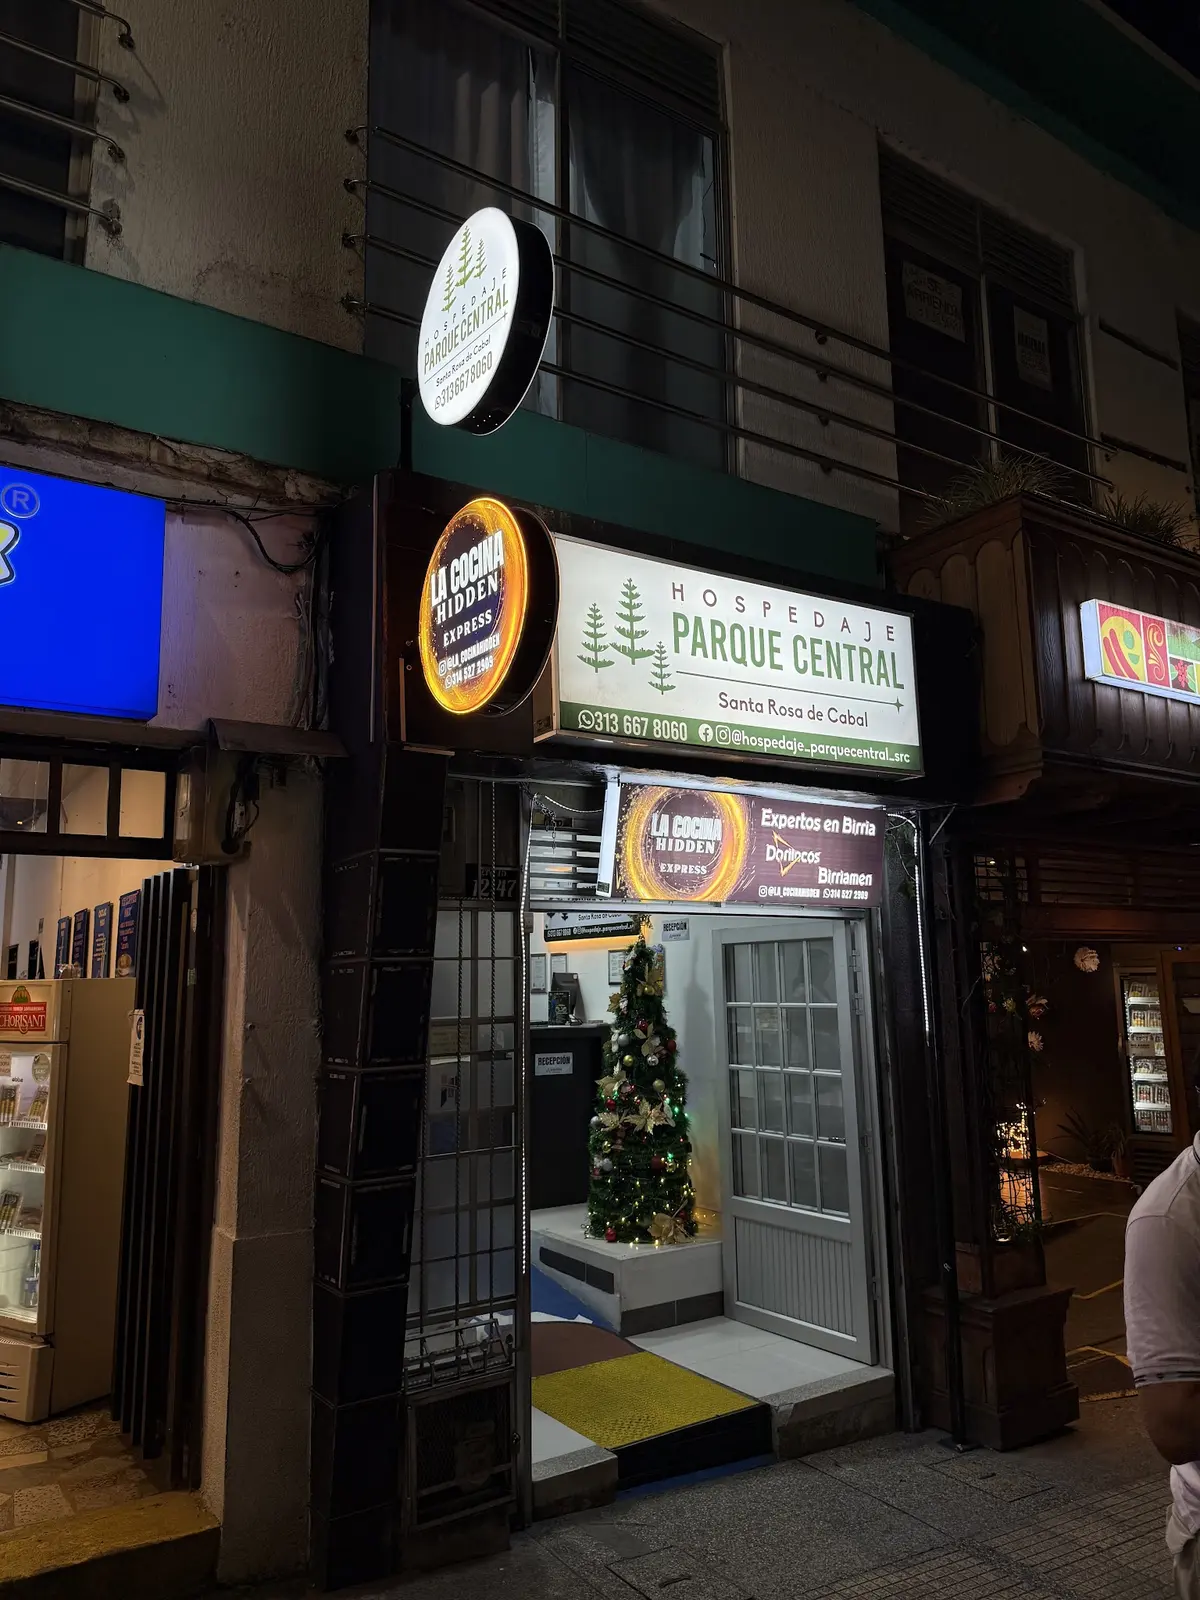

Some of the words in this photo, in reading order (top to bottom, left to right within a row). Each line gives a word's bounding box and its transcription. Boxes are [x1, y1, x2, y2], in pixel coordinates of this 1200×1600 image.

[424, 267, 507, 348] HOSPEDAJE
[436, 369, 451, 387] Santa
[452, 359, 465, 377] Rosa
[465, 352, 473, 364] de
[473, 334, 491, 359] Cabal
[430, 565, 448, 607] LA
[450, 530, 504, 593] COCINA
[436, 572, 498, 625] HIDDEN
[672, 582, 895, 642] HOSPEDAJE
[443, 608, 492, 648] EXPRESS
[672, 612, 783, 671] PARQUE
[793, 634, 905, 690] CENTRAL
[718, 692, 764, 714] Santa
[768, 700, 804, 720] Rosa
[807, 704, 824, 722] de
[827, 708, 868, 728] Cabal
[594, 711, 618, 732] 313
[623, 716, 648, 736] 667
[653, 719, 688, 742] 8060
[731, 730, 911, 764] @hospedaje_parquecentral_src
[651, 812, 669, 837] LA
[672, 815, 722, 840] COCINA
[761, 808, 820, 831] Expertos
[824, 818, 840, 832] en
[842, 816, 876, 836] Birria
[656, 838, 715, 854] HIDDEN
[660, 862, 707, 874] EXPRESS
[818, 866, 872, 886] Birriamen
[538, 1055, 570, 1066] RECEPCIÓN
